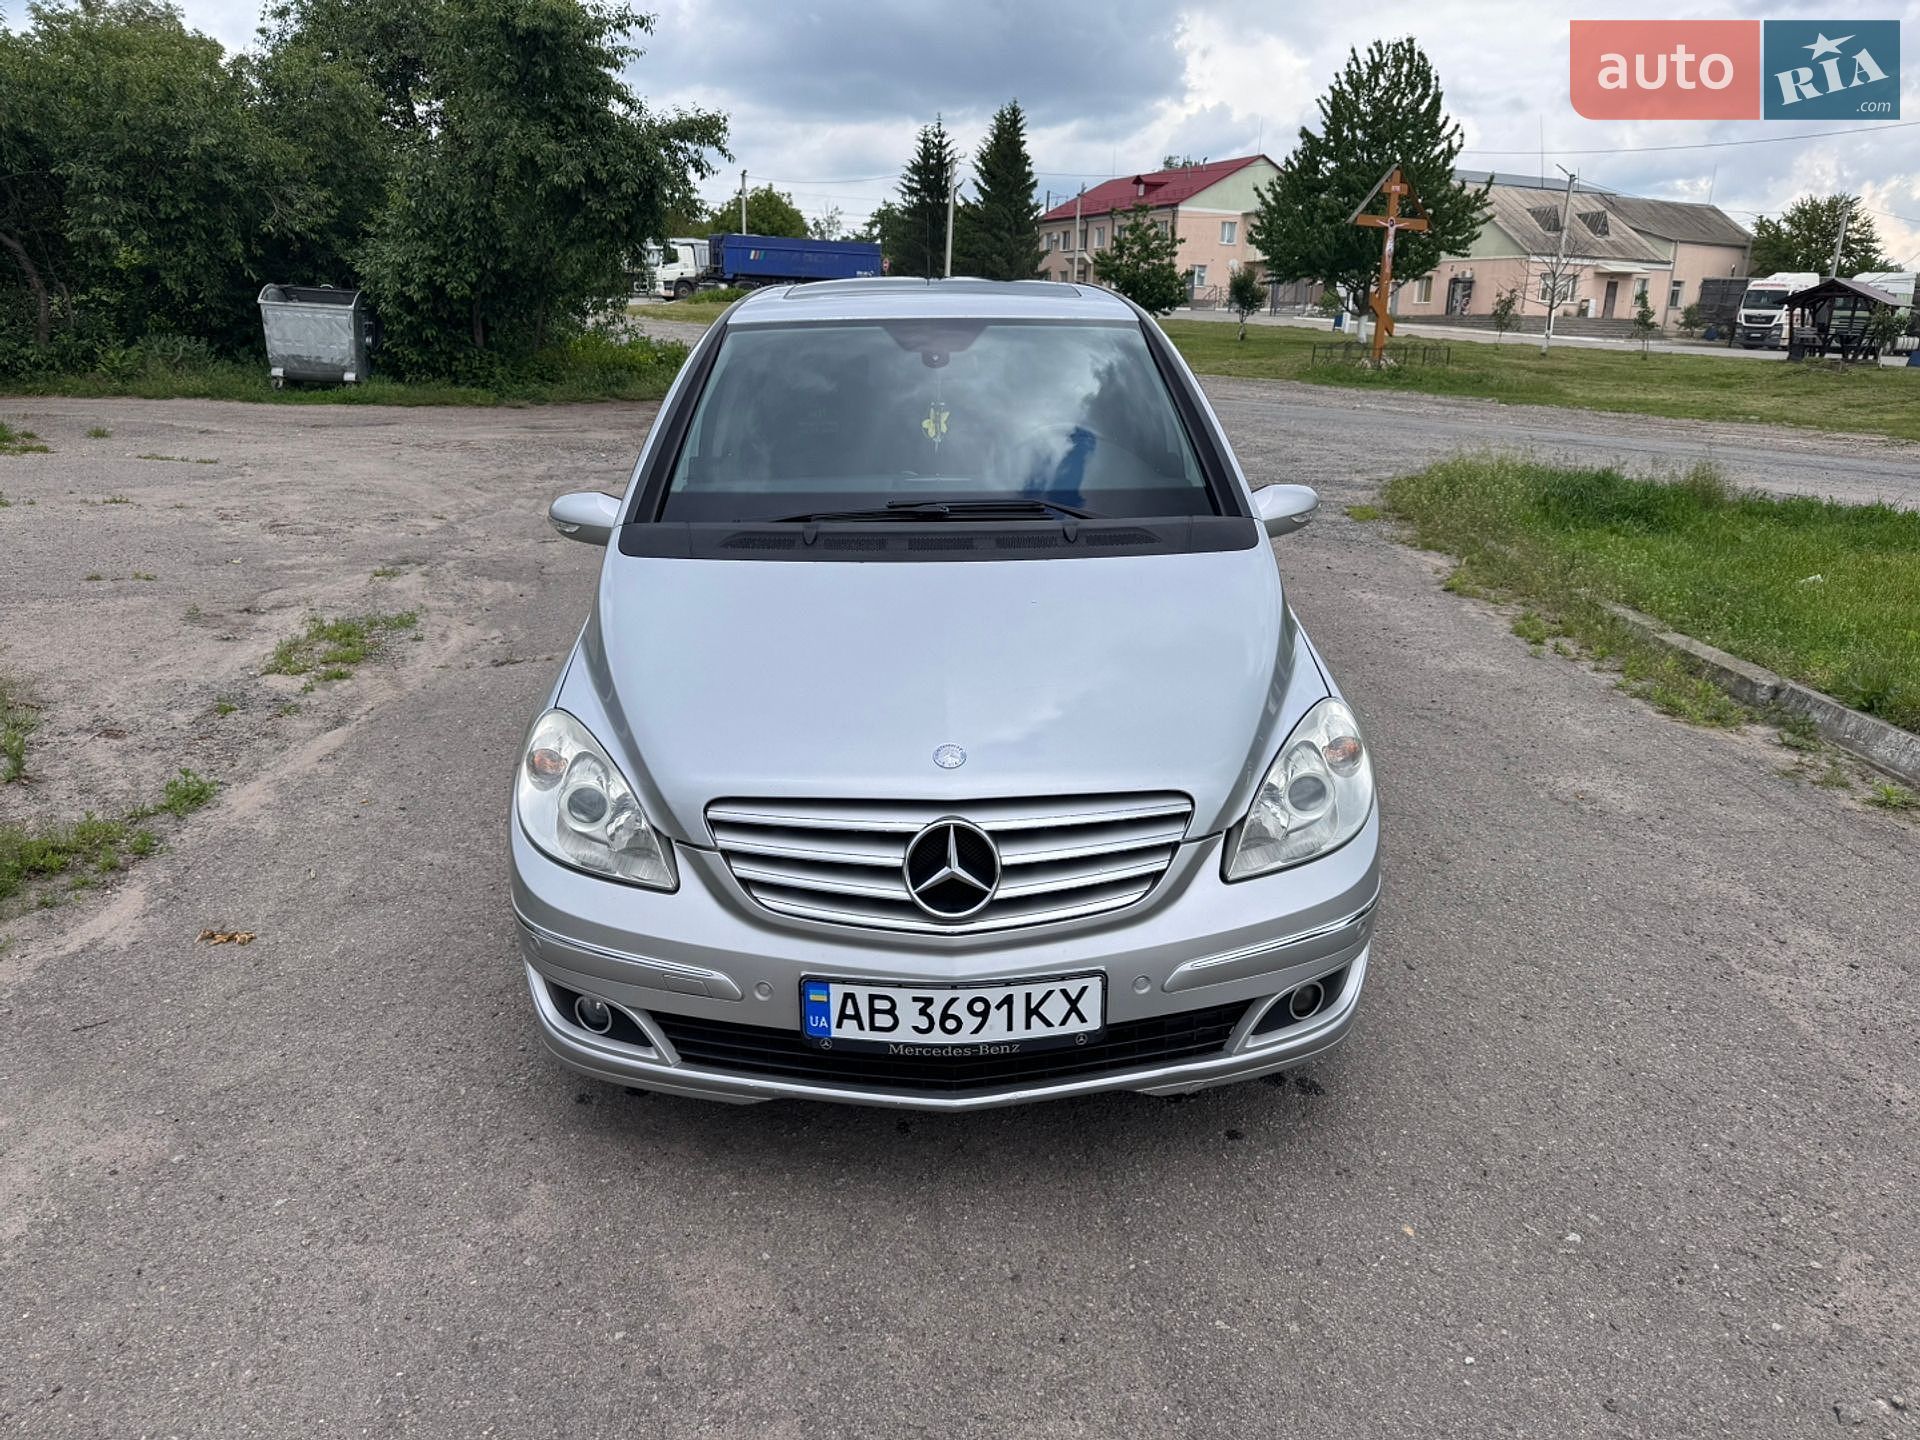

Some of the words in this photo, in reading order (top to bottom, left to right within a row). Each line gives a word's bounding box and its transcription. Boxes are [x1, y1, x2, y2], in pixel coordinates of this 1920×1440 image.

[836, 992, 899, 1032] AB
[810, 1015, 829, 1029] UA
[888, 1043, 1020, 1057] Mercedes-Benz
